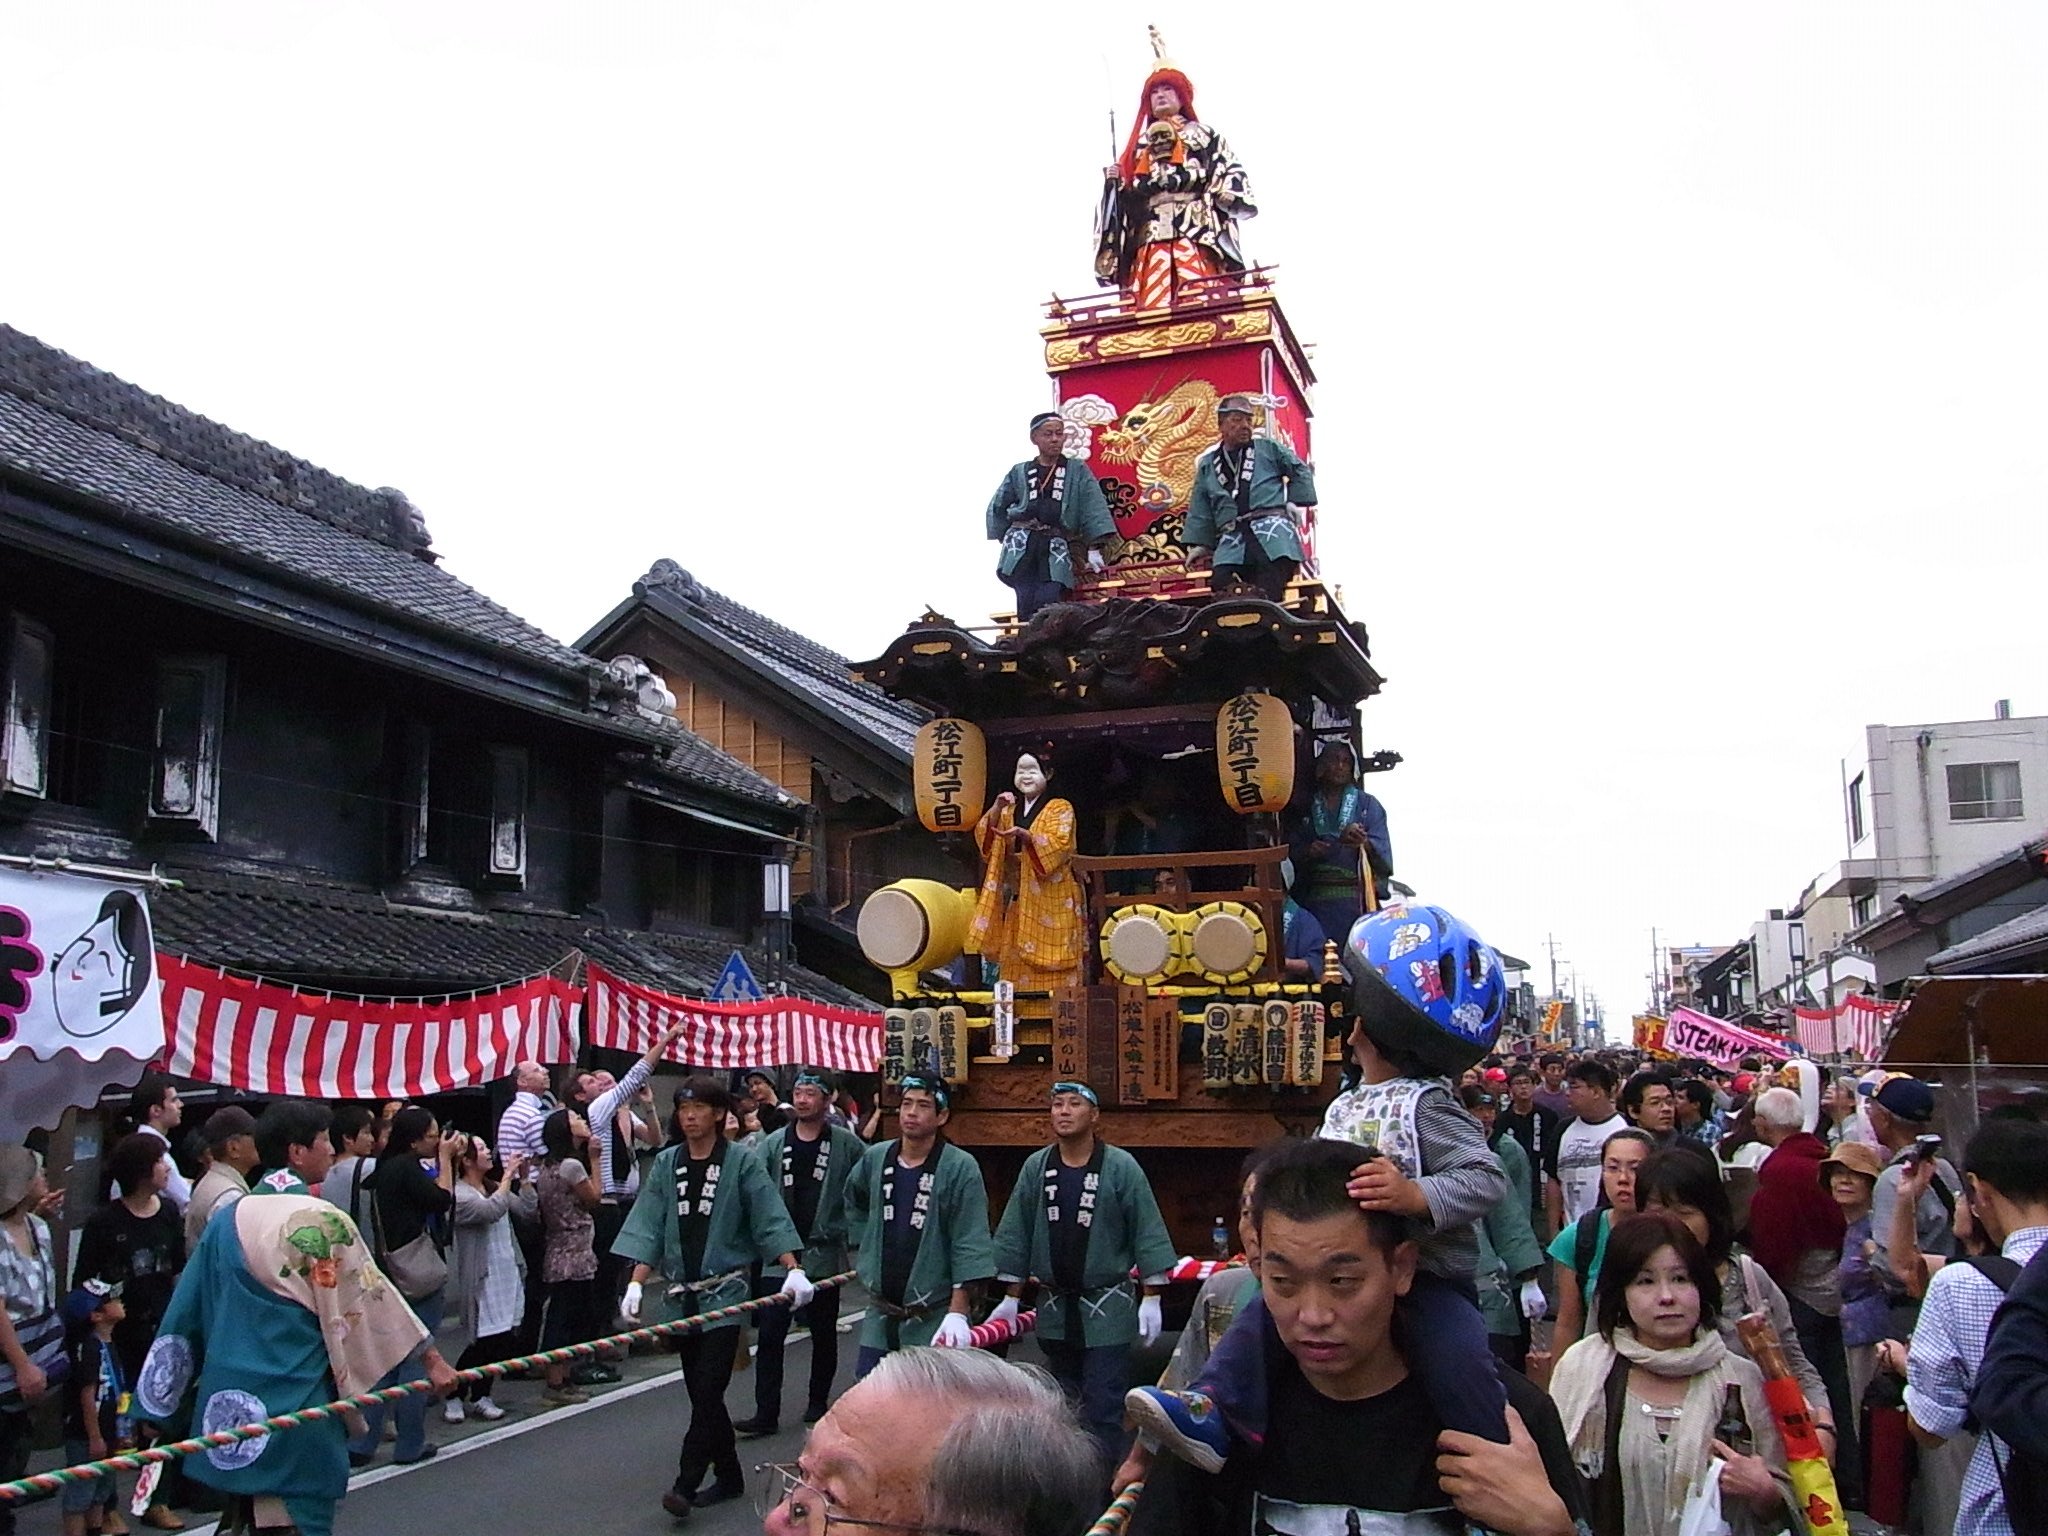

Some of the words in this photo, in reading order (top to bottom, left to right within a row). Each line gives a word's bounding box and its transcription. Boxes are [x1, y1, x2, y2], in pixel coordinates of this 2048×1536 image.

[931, 721, 964, 826] 松江町一丁目
[1226, 695, 1264, 808] 松江町一丁目
[1674, 1020, 1729, 1060] STEAK
[782, 1146, 794, 1187] 一丁目
[812, 1140, 832, 1181] 松江町
[676, 1165, 690, 1217] 一丁目
[698, 1164, 721, 1216] 松江町
[883, 1166, 894, 1222] 一丁目
[909, 1172, 936, 1229] 松江町
[1044, 1169, 1060, 1222] 一丁目
[1076, 1172, 1099, 1228] 松江町
